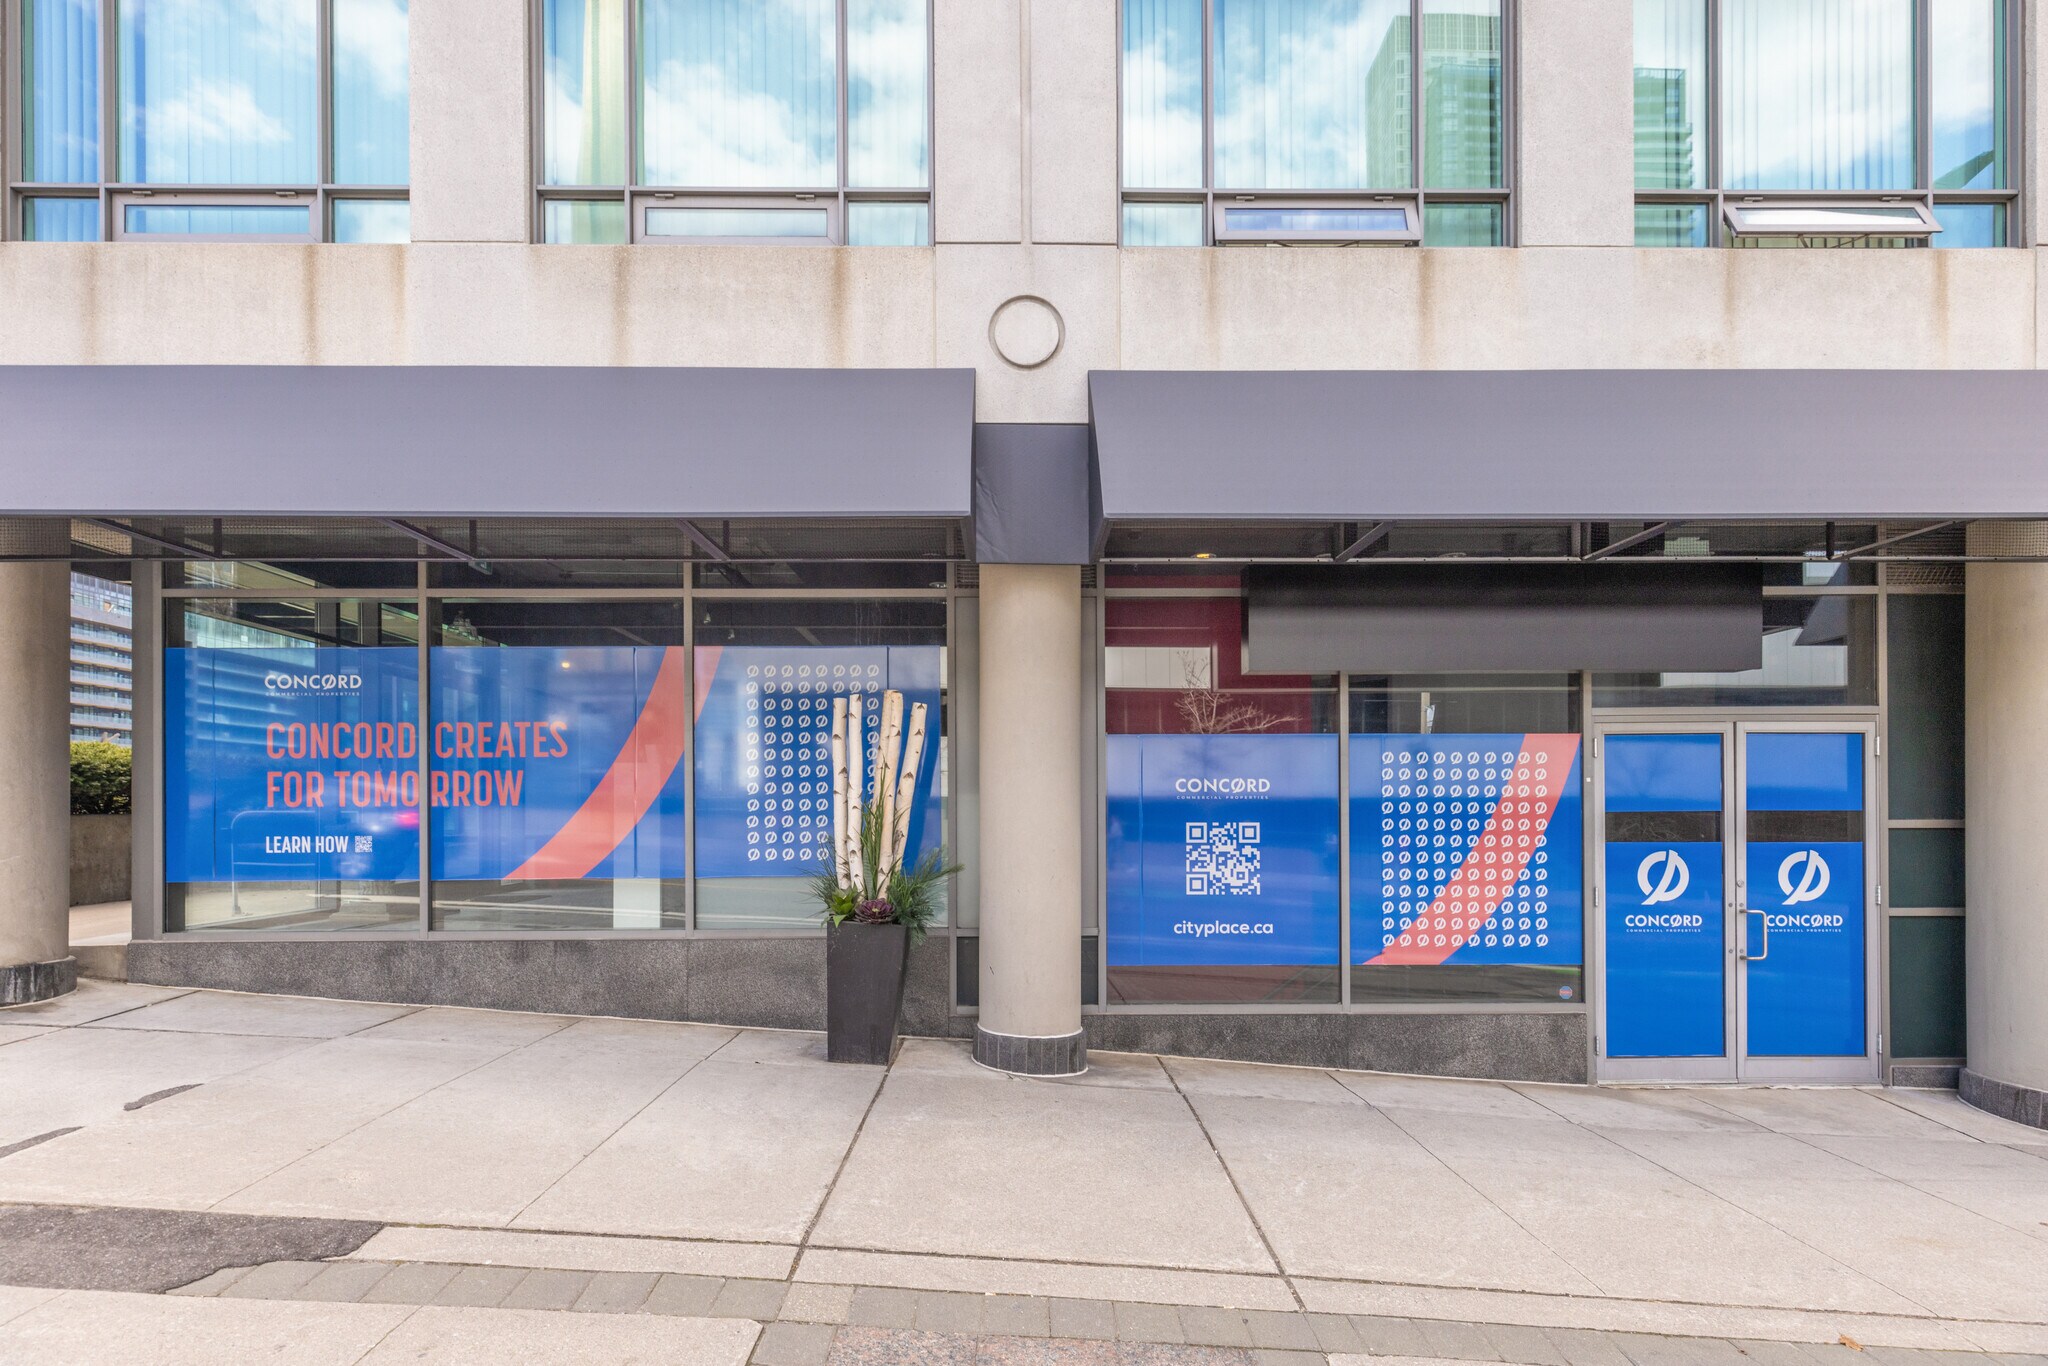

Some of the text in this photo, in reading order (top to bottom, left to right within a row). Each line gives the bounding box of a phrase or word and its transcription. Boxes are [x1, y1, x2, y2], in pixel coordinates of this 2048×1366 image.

[266, 721, 569, 759] CONCORD CREATES
[266, 769, 524, 808] FOR TOMORROW
[265, 835, 349, 854] LEARN HOW
[1173, 920, 1274, 938] cityplace.ca
